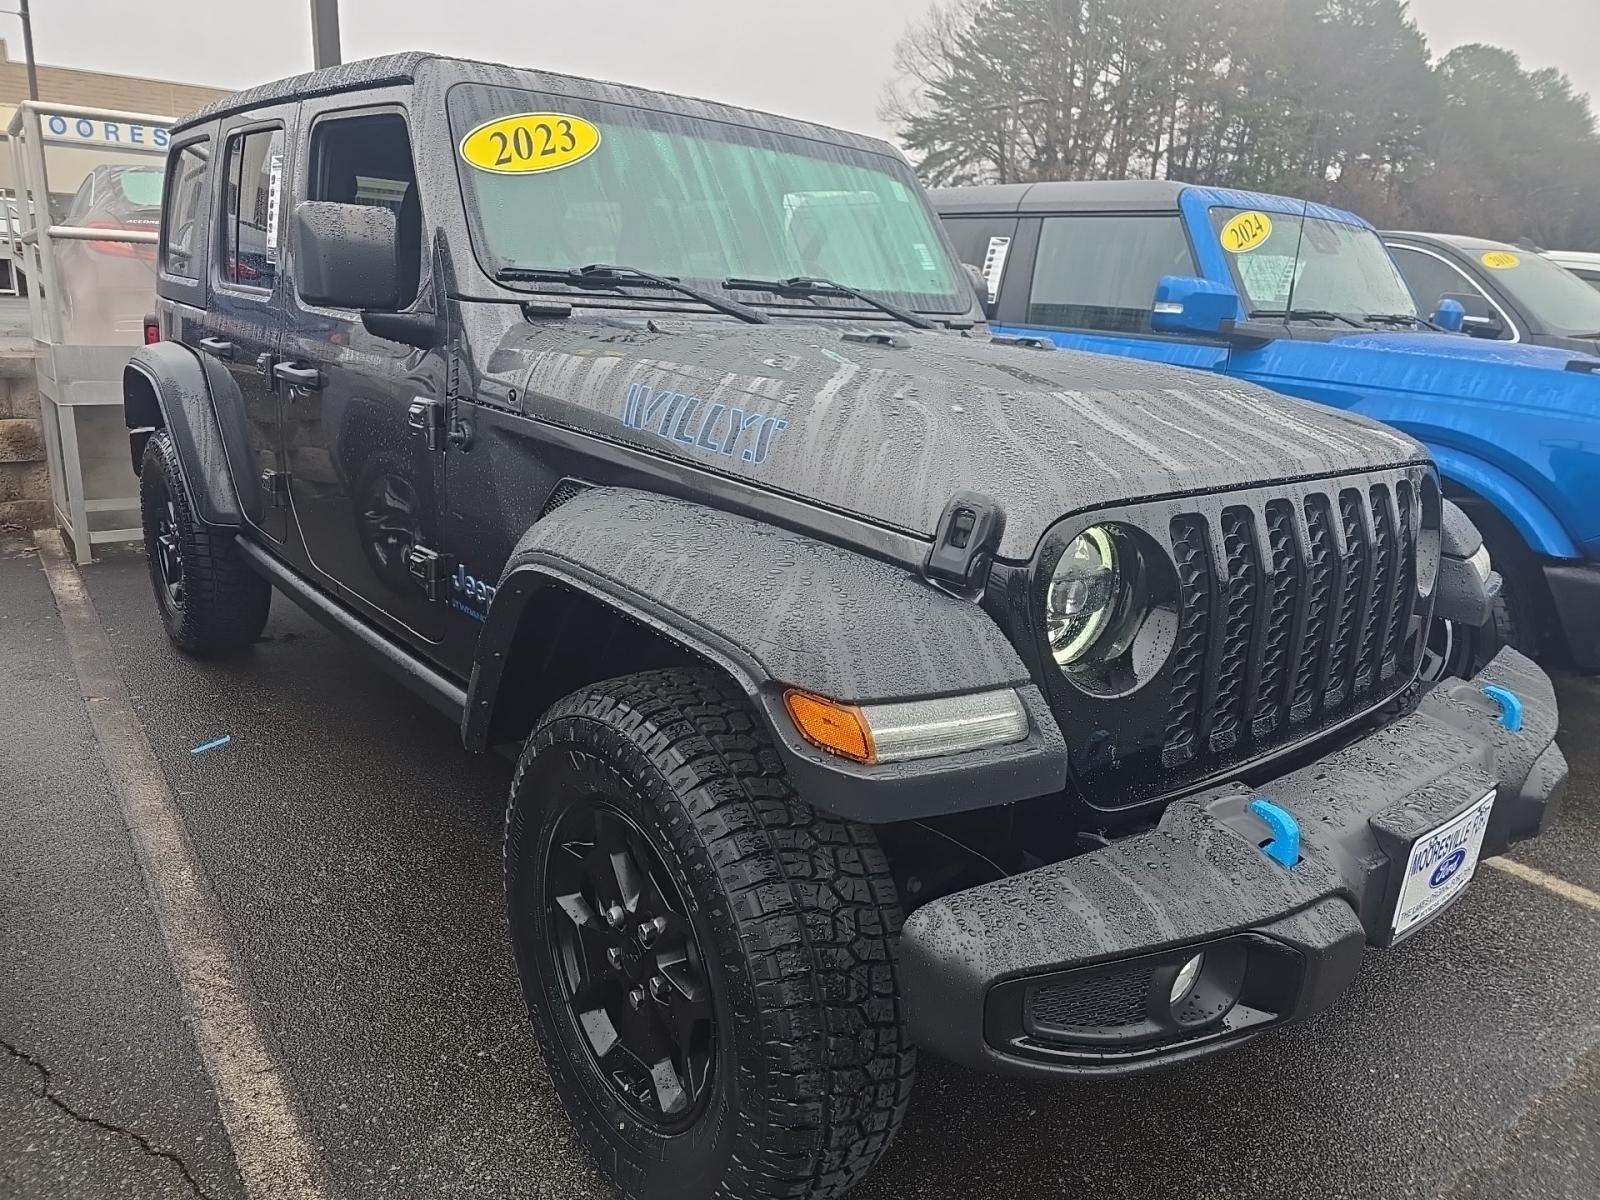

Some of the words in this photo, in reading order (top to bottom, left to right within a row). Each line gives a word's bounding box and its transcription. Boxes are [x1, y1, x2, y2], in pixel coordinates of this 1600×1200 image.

[490, 119, 576, 166] 2023
[1231, 213, 1265, 248] 2024
[622, 383, 789, 464] WILLYS
